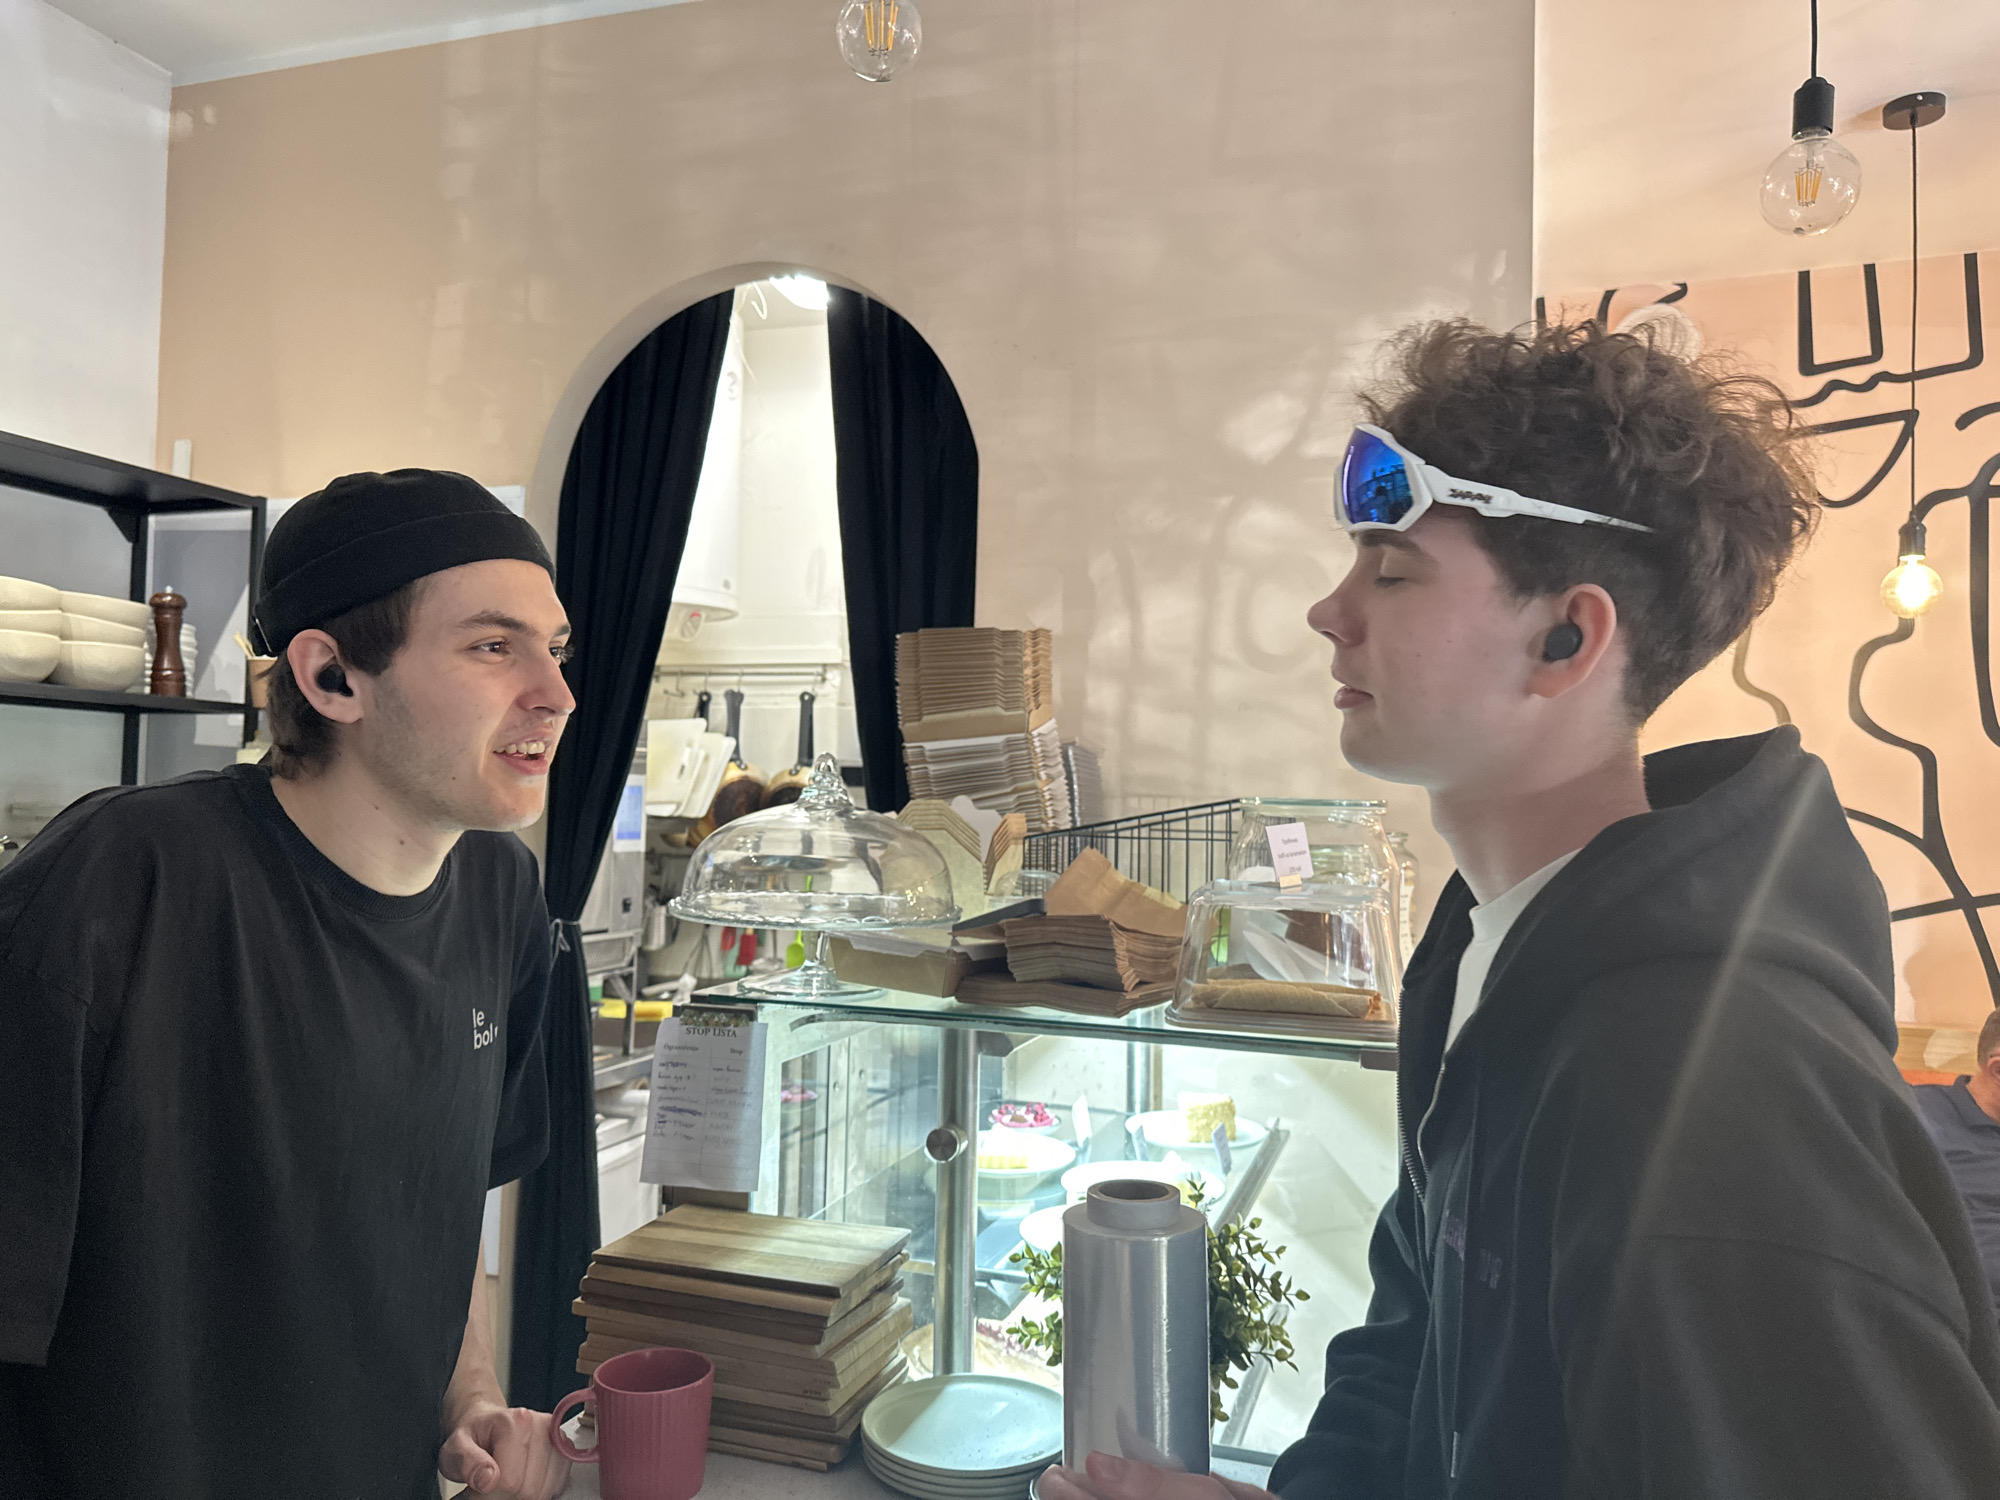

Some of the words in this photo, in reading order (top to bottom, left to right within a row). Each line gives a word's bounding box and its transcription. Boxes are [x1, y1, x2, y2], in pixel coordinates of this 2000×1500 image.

[472, 1007, 485, 1028] le
[685, 1027, 711, 1036] STOP
[713, 1028, 737, 1038] LISTA
